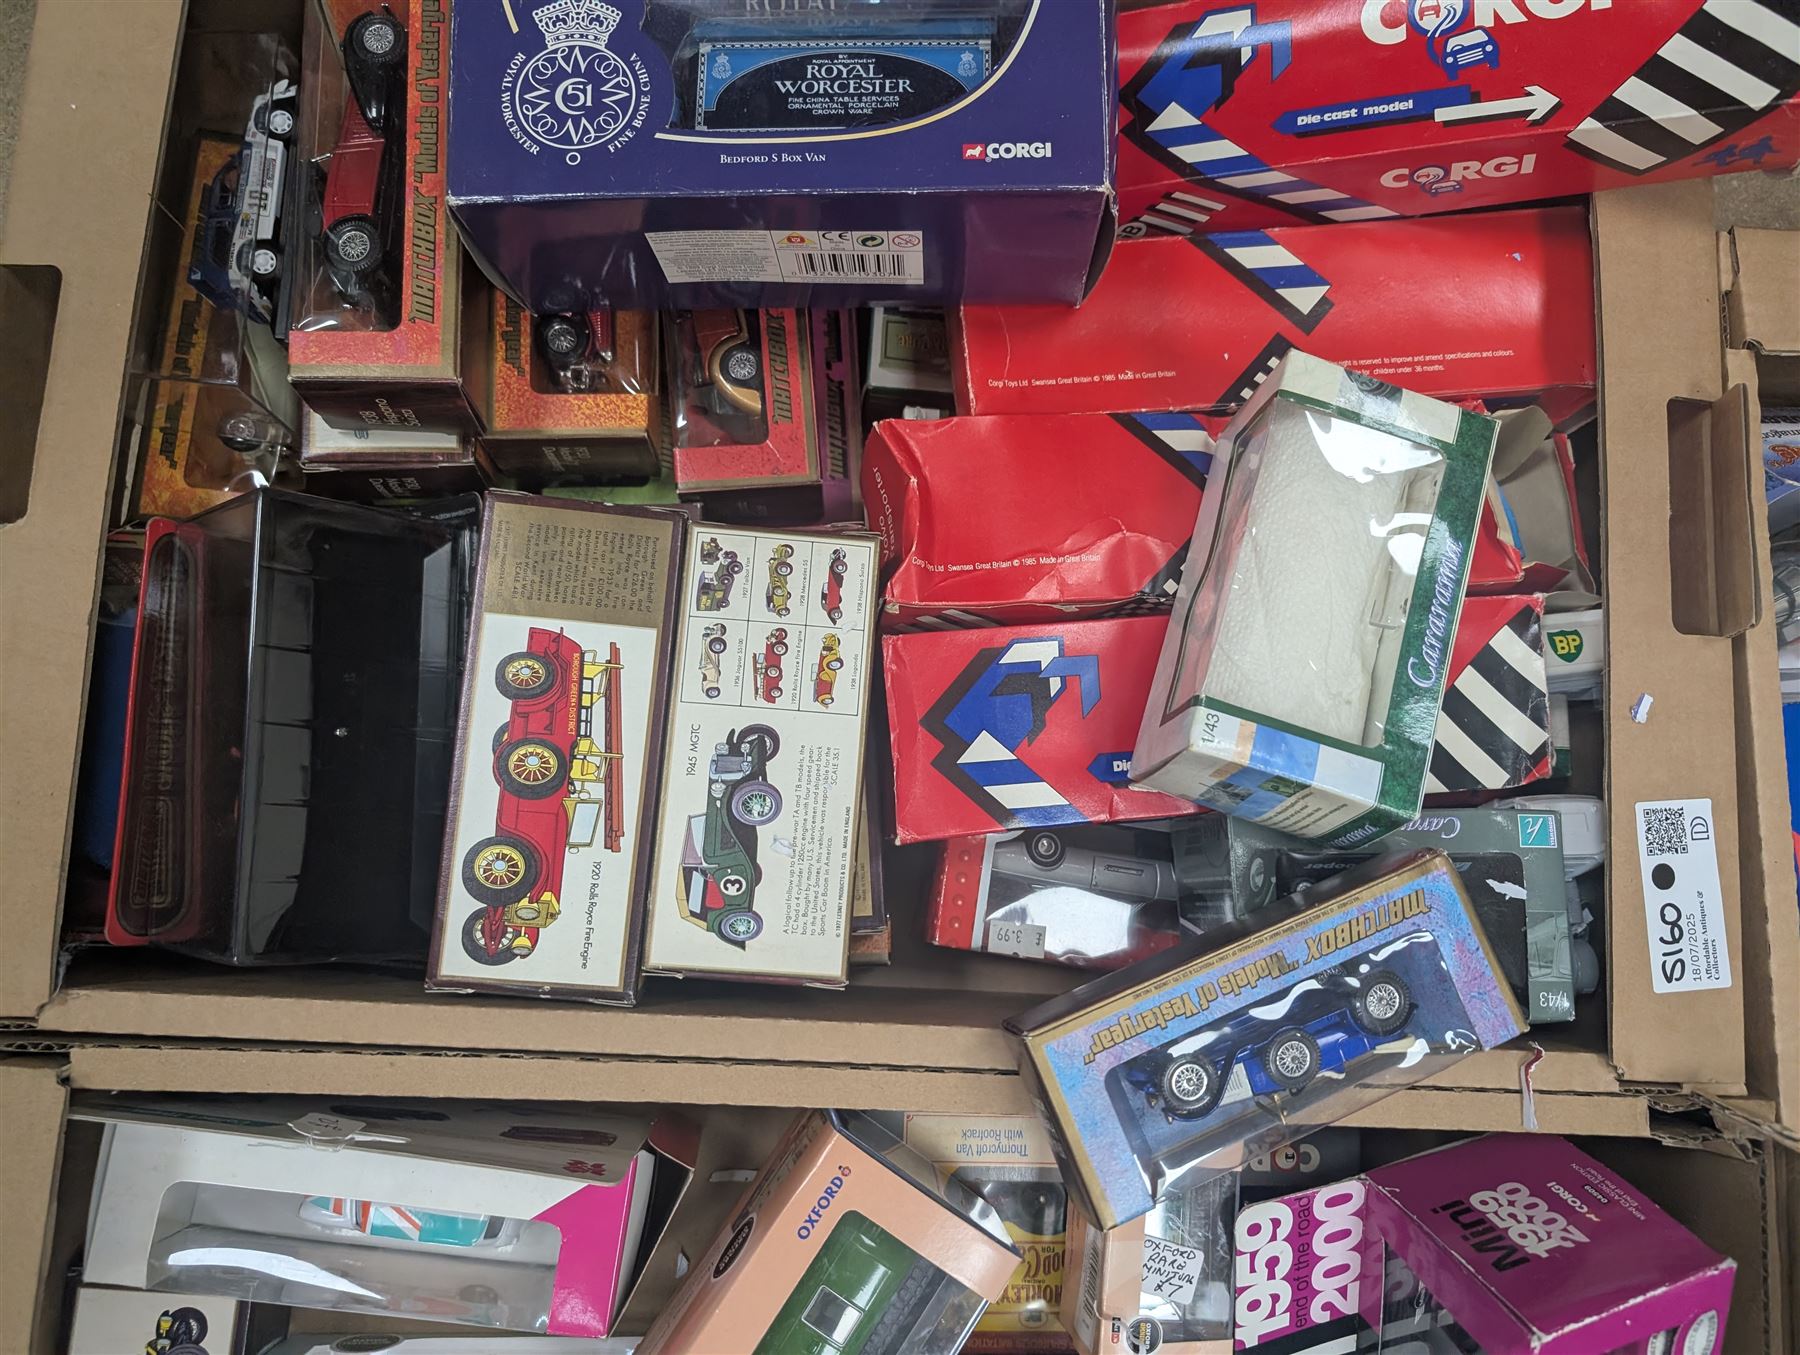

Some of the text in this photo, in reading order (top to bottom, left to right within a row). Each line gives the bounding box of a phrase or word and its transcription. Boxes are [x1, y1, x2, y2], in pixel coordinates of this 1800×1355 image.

[418, 0, 445, 104] of Yesterye
[806, 64, 883, 79] ROYAL
[775, 79, 915, 95] WORCESTER
[501, 52, 540, 155] ROYAL WORCESTER
[608, 52, 651, 153] FINE BONE CHINA
[1297, 99, 1414, 127] Die-cast model
[720, 154, 769, 164] BEDFORD
[772, 153, 779, 163] S
[781, 153, 802, 163] BOX
[986, 142, 1052, 159] CORGI
[1379, 153, 1537, 192] CORGI
[411, 195, 438, 323] MATCHBOX
[764, 311, 794, 425] MATCHBOX
[1391, 356, 1412, 364] improve
[1445, 352, 1481, 360] specifications
[1374, 367, 1395, 375] children
[1005, 379, 1018, 387] Toys
[992, 560, 1011, 569] Britain
[1022, 558, 1036, 566] 1985
[1406, 537, 1464, 689] Cararama
[1557, 634, 1581, 655] BP
[569, 682, 578, 702] GREEN
[567, 707, 576, 735] DISTRICT
[1201, 713, 1219, 744] 1/43
[686, 723, 701, 776] 1945 MGTC
[815, 746, 823, 762] back
[805, 765, 814, 786] speed
[813, 764, 822, 790] shipped
[830, 763, 839, 785] SCALE
[803, 786, 811, 800] four
[793, 809, 800, 818] TA
[801, 818, 809, 841] engine
[808, 806, 818, 845] Servicemen
[1401, 816, 1461, 839] Cara
[817, 826, 825, 850] vehicle
[815, 851, 823, 863] this
[823, 835, 833, 867] America.
[789, 860, 795, 868] to
[789, 869, 796, 878] up
[806, 863, 814, 881] many
[823, 868, 830, 876] in
[723, 877, 743, 892] 3
[785, 879, 794, 902] follow
[795, 867, 805, 895] cylinder
[804, 882, 812, 892] by
[821, 877, 829, 897] Boom
[801, 893, 811, 918] Bought
[811, 890, 819, 913] United
[578, 860, 602, 969] 1920 Rolls Royce Fire Engine
[783, 902, 793, 927] logical
[818, 914, 827, 936] Sports
[791, 924, 799, 935] TC
[810, 928, 816, 936] to
[996, 927, 1024, 944] 3.99
[1296, 887, 1432, 966] MATCHBOX
[1659, 902, 1686, 984] S160
[1686, 912, 1702, 982] 18/07/2025
[1699, 900, 1713, 982] Affordable Antiques
[1710, 938, 1720, 981] Collectors
[1192, 981, 1221, 1011] of
[1539, 990, 1568, 1009] 1/43
[961, 1128, 1024, 1140] with Roofrack
[956, 1143, 1029, 1158] Thornycroft Van
[1547, 1180, 1589, 1214] CORGI
[797, 1177, 844, 1242] OXFORD
[1496, 1181, 1591, 1249] 2000
[1469, 1188, 1563, 1259] 1959
[1431, 1199, 1531, 1273] Mini
[1144, 1239, 1196, 1260] OXFORD
[1310, 1180, 1367, 1324] 2000
[1293, 1196, 1311, 1329] end of the road
[1235, 1201, 1294, 1348] 1959
